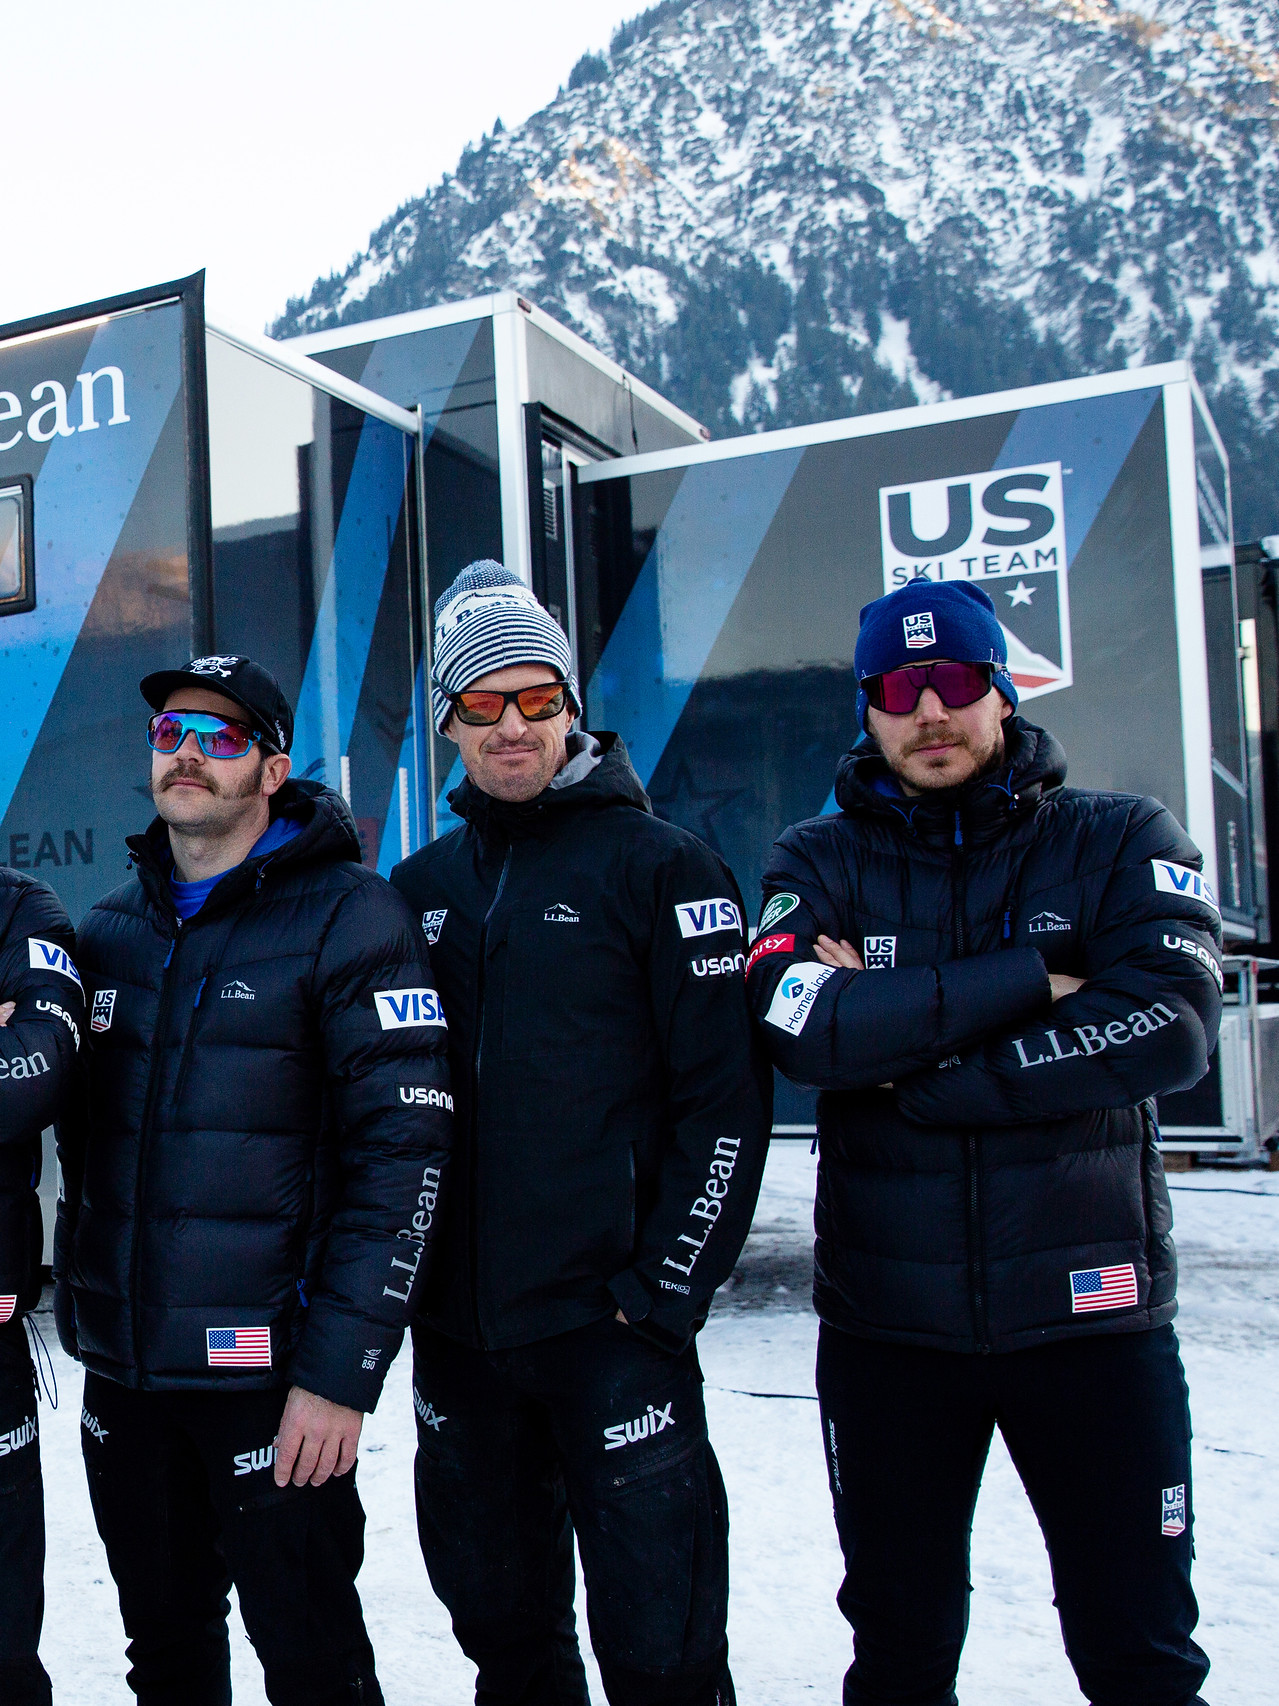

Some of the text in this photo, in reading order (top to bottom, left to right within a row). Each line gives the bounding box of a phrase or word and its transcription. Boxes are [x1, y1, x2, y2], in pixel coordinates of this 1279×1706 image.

[887, 474, 1055, 558] US
[892, 547, 1058, 586] SKI TEAM
[905, 614, 931, 627] US
[1159, 863, 1218, 907] VIS
[423, 911, 445, 924] US
[544, 913, 580, 922] L.L.Bean
[1028, 922, 1071, 933] L.L.Bean
[866, 938, 894, 955] US
[34, 942, 81, 981] VIS
[691, 953, 745, 977] USAN
[96, 991, 115, 1006] US
[221, 989, 256, 1000] L.L.Bean
[399, 1087, 454, 1113] USANA
[662, 1136, 741, 1277] L.L.Bean
[382, 1166, 441, 1304] L.L.Bean
[361, 1359, 376, 1370] 850
[1164, 1486, 1184, 1505] US
